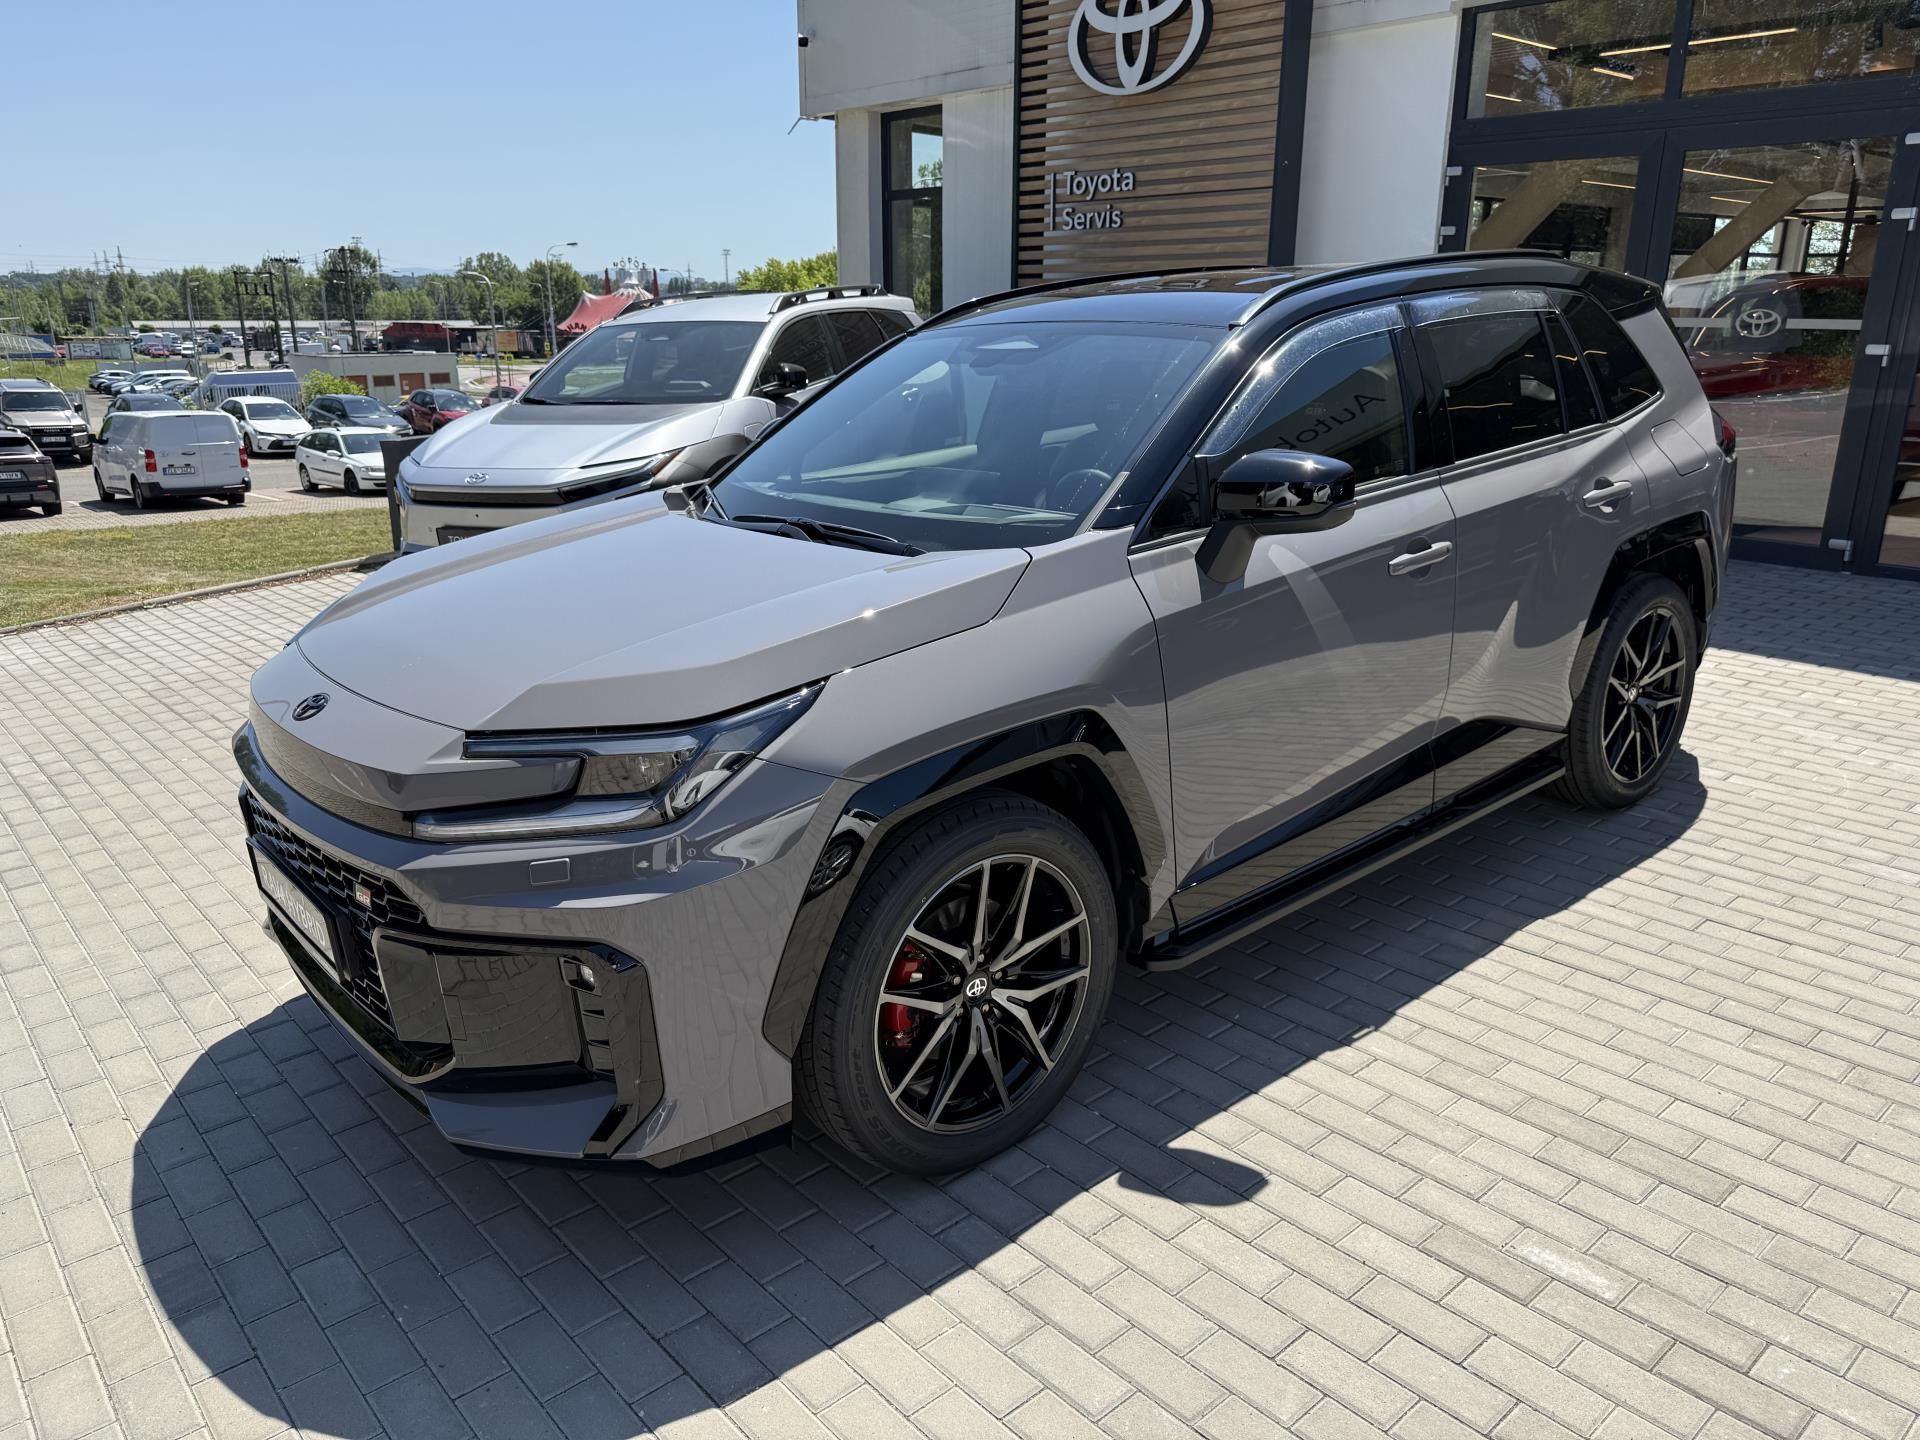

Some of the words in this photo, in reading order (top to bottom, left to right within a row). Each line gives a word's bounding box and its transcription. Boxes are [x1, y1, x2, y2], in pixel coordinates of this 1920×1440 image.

[1063, 168, 1134, 200] Toyota
[1062, 204, 1121, 230] Servis
[356, 891, 371, 908] GR
[286, 892, 326, 947] HYBRID
